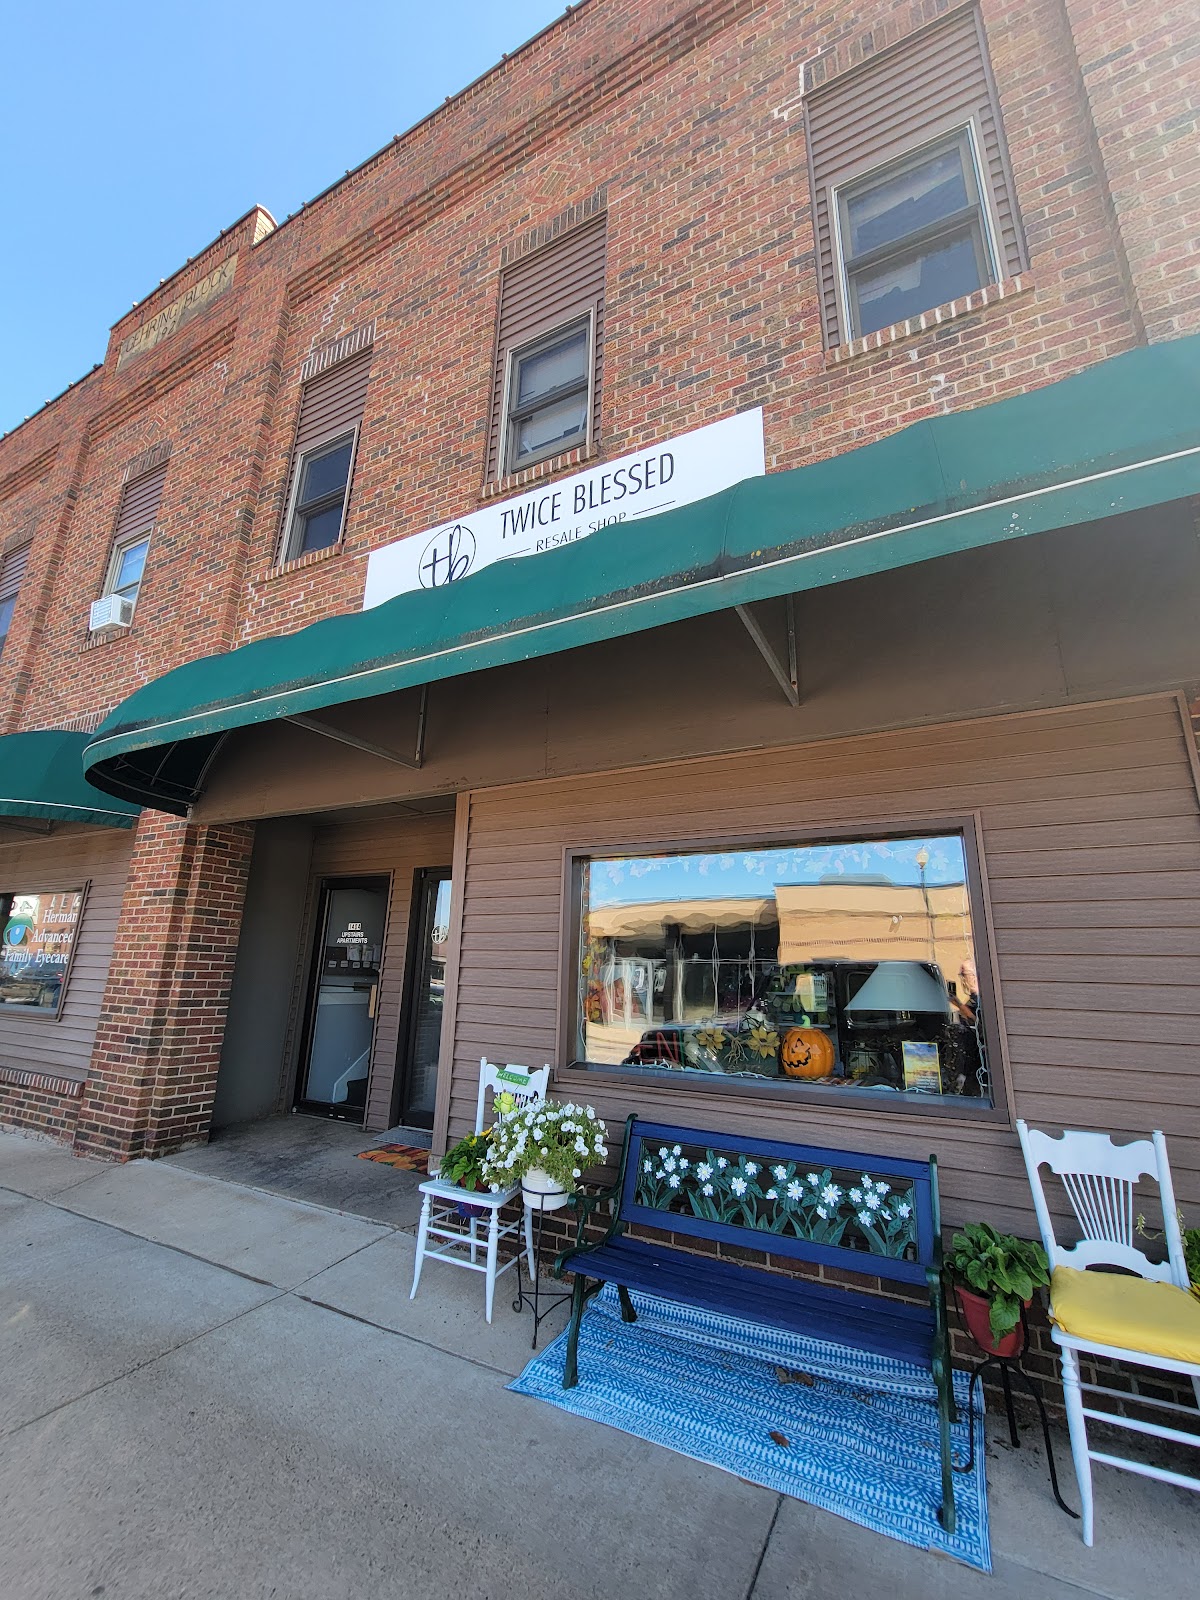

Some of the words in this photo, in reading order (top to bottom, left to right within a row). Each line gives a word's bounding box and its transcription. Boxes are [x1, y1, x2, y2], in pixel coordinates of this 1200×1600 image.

[125, 303, 179, 353] GEHRING
[183, 261, 231, 309] BLOCK
[501, 491, 562, 539] TWICE
[573, 452, 675, 515] BLESSED
[536, 526, 582, 552] RESALE
[588, 511, 627, 536] SHOP
[42, 909, 78, 924] Herman
[31, 928, 75, 943] Advanced
[4, 948, 33, 966] Family
[34, 948, 70, 967] Eyecare
[498, 1072, 528, 1085] WELCOME
